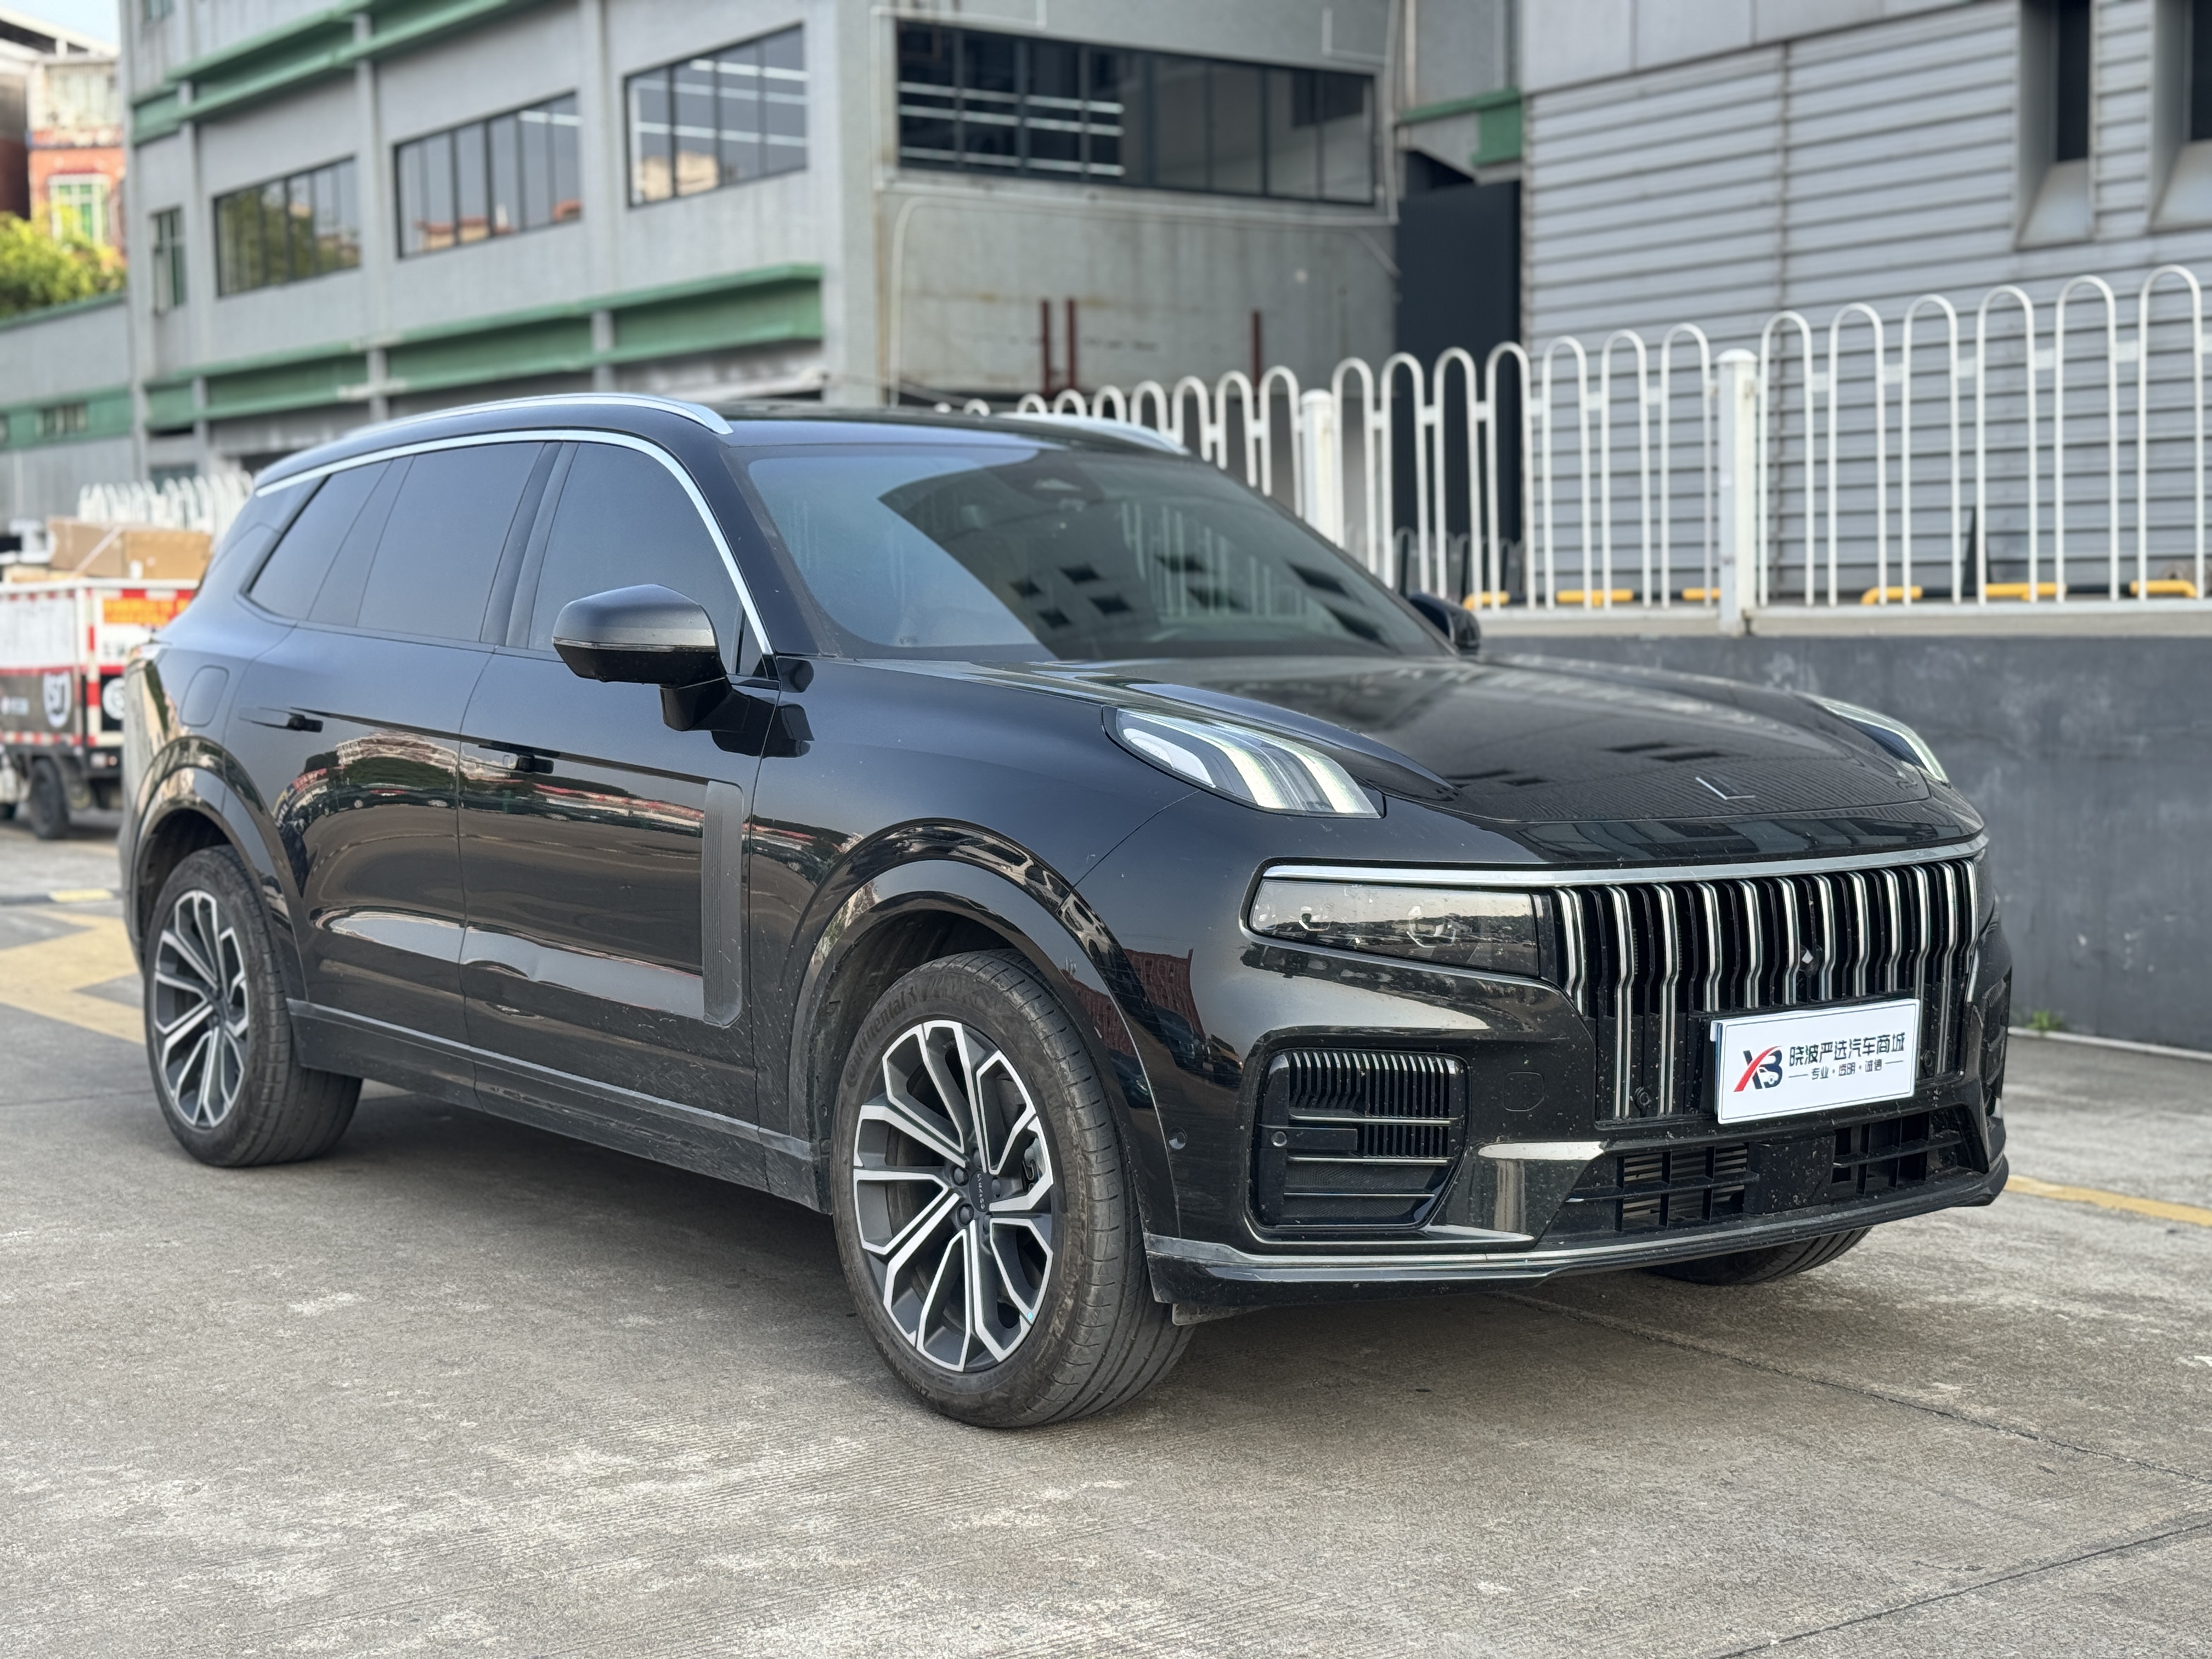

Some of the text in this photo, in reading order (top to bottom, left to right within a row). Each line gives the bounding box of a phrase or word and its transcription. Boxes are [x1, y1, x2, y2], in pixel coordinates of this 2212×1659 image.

[845, 991, 907, 1087] Continental
[1788, 1031, 1906, 1067] 晓波严选汽车商城
